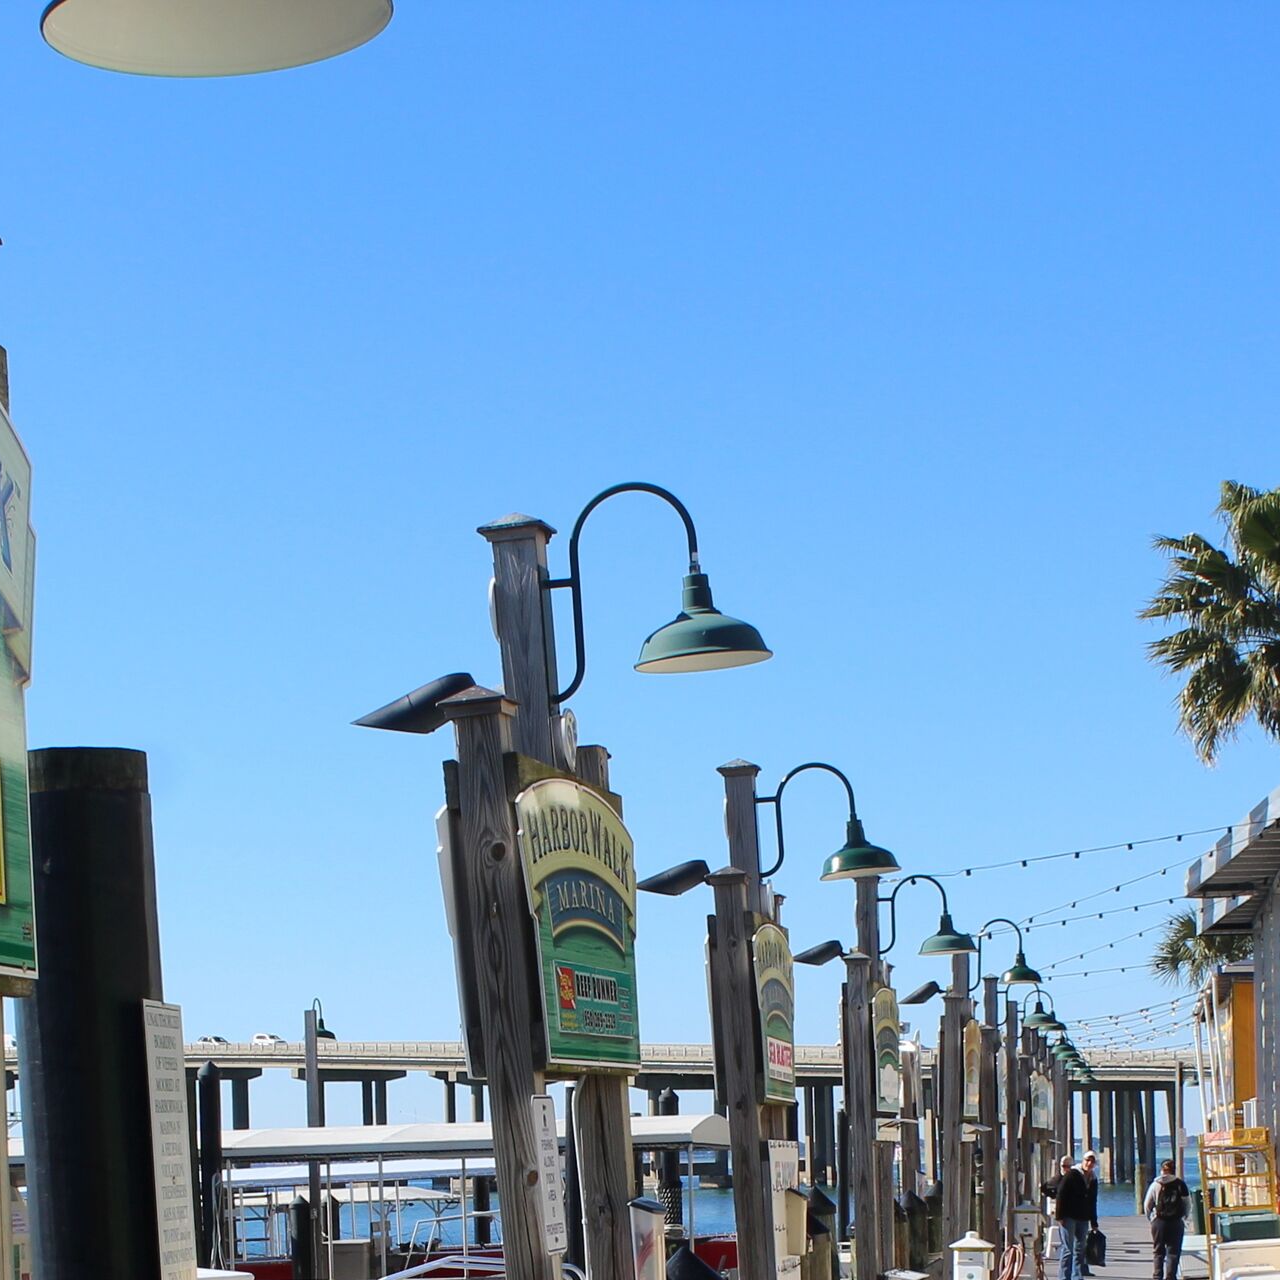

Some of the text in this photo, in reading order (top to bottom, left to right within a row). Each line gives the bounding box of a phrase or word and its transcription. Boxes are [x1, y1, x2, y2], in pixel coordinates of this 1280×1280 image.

[528, 804, 631, 893] HARBORWALK
[556, 880, 616, 926] MARINA
[575, 972, 619, 1004] REEF RUNNER
